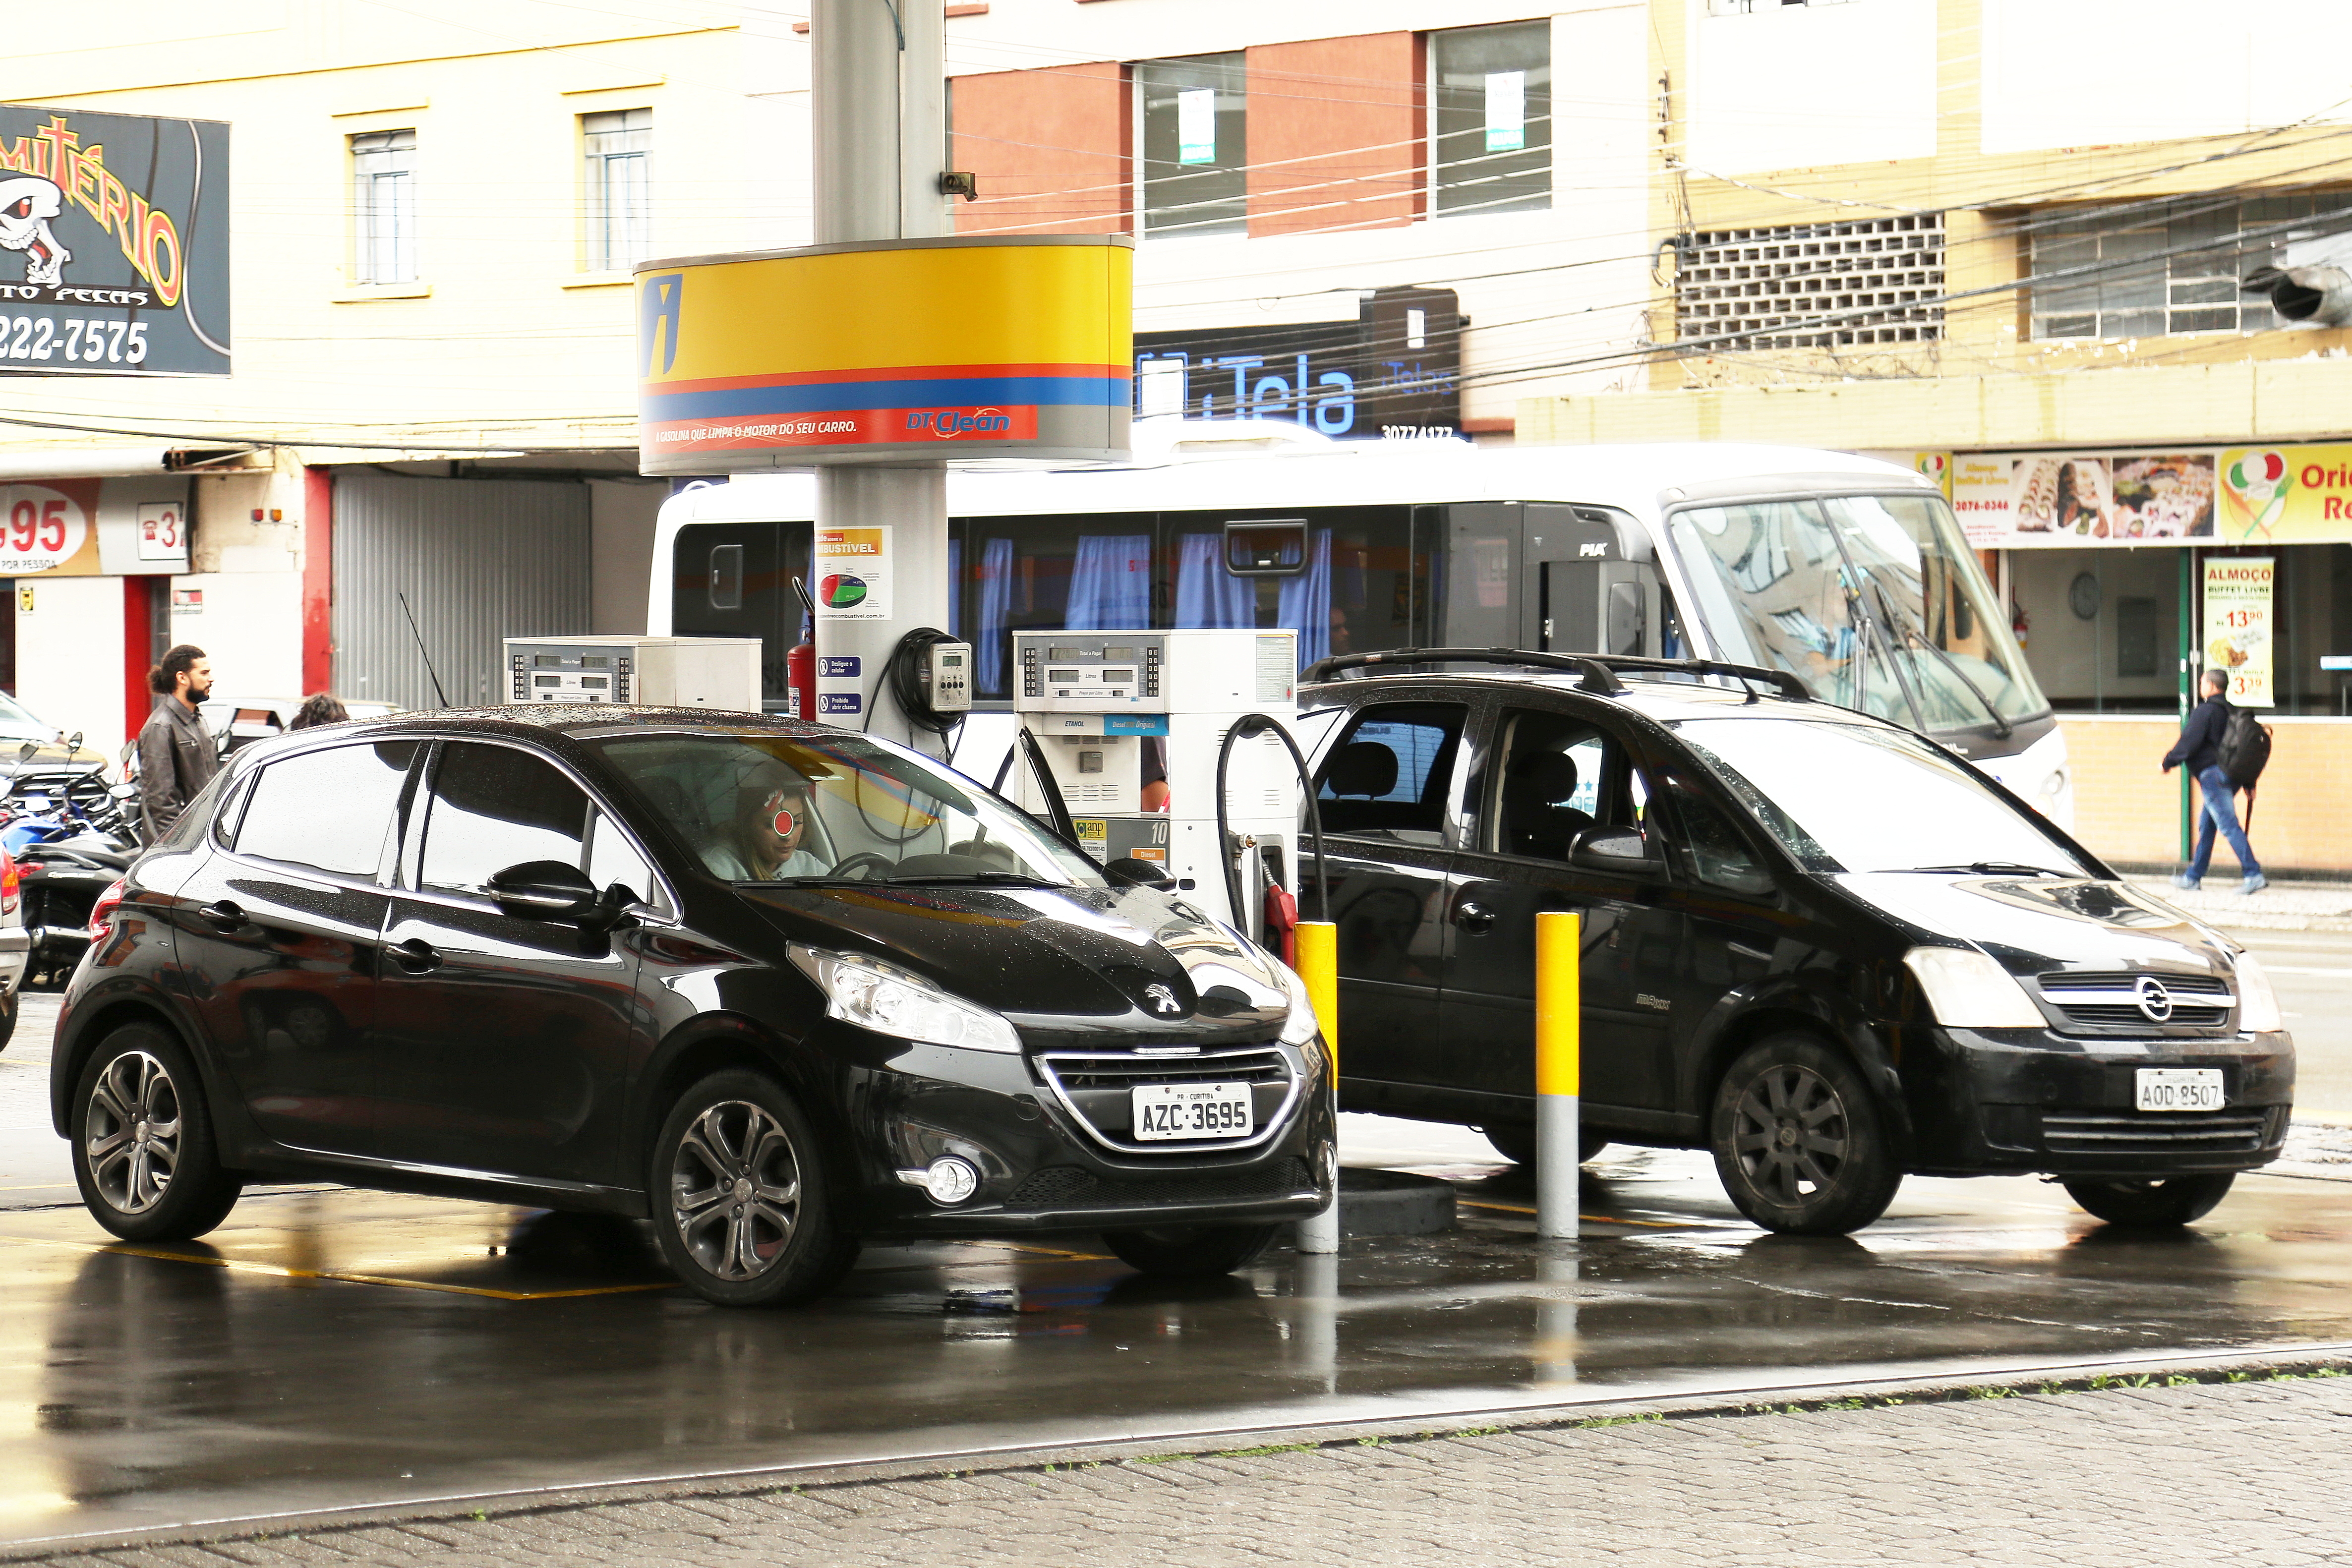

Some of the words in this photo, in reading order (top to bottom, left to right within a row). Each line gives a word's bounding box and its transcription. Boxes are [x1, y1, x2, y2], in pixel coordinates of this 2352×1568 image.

[906, 412, 934, 429] DT
[936, 411, 1010, 432] Clean
[655, 431, 660, 443] A
[660, 429, 690, 442] GASOLINA
[691, 428, 707, 440] QUE
[708, 426, 732, 439] LIMPA
[734, 426, 741, 437] O
[744, 424, 777, 437] MOTOR
[779, 423, 794, 435] DO
[796, 422, 816, 434] SEU
[818, 420, 857, 433] CARRO.
[2301, 462, 2352, 489] Ori
[22, 560, 57, 569] PESSOA
[2209, 569, 2271, 583] ALMOÇO
[1136, 721, 1156, 729] Original
[1087, 822, 1103, 835] anp
[1152, 822, 1168, 844] 10
